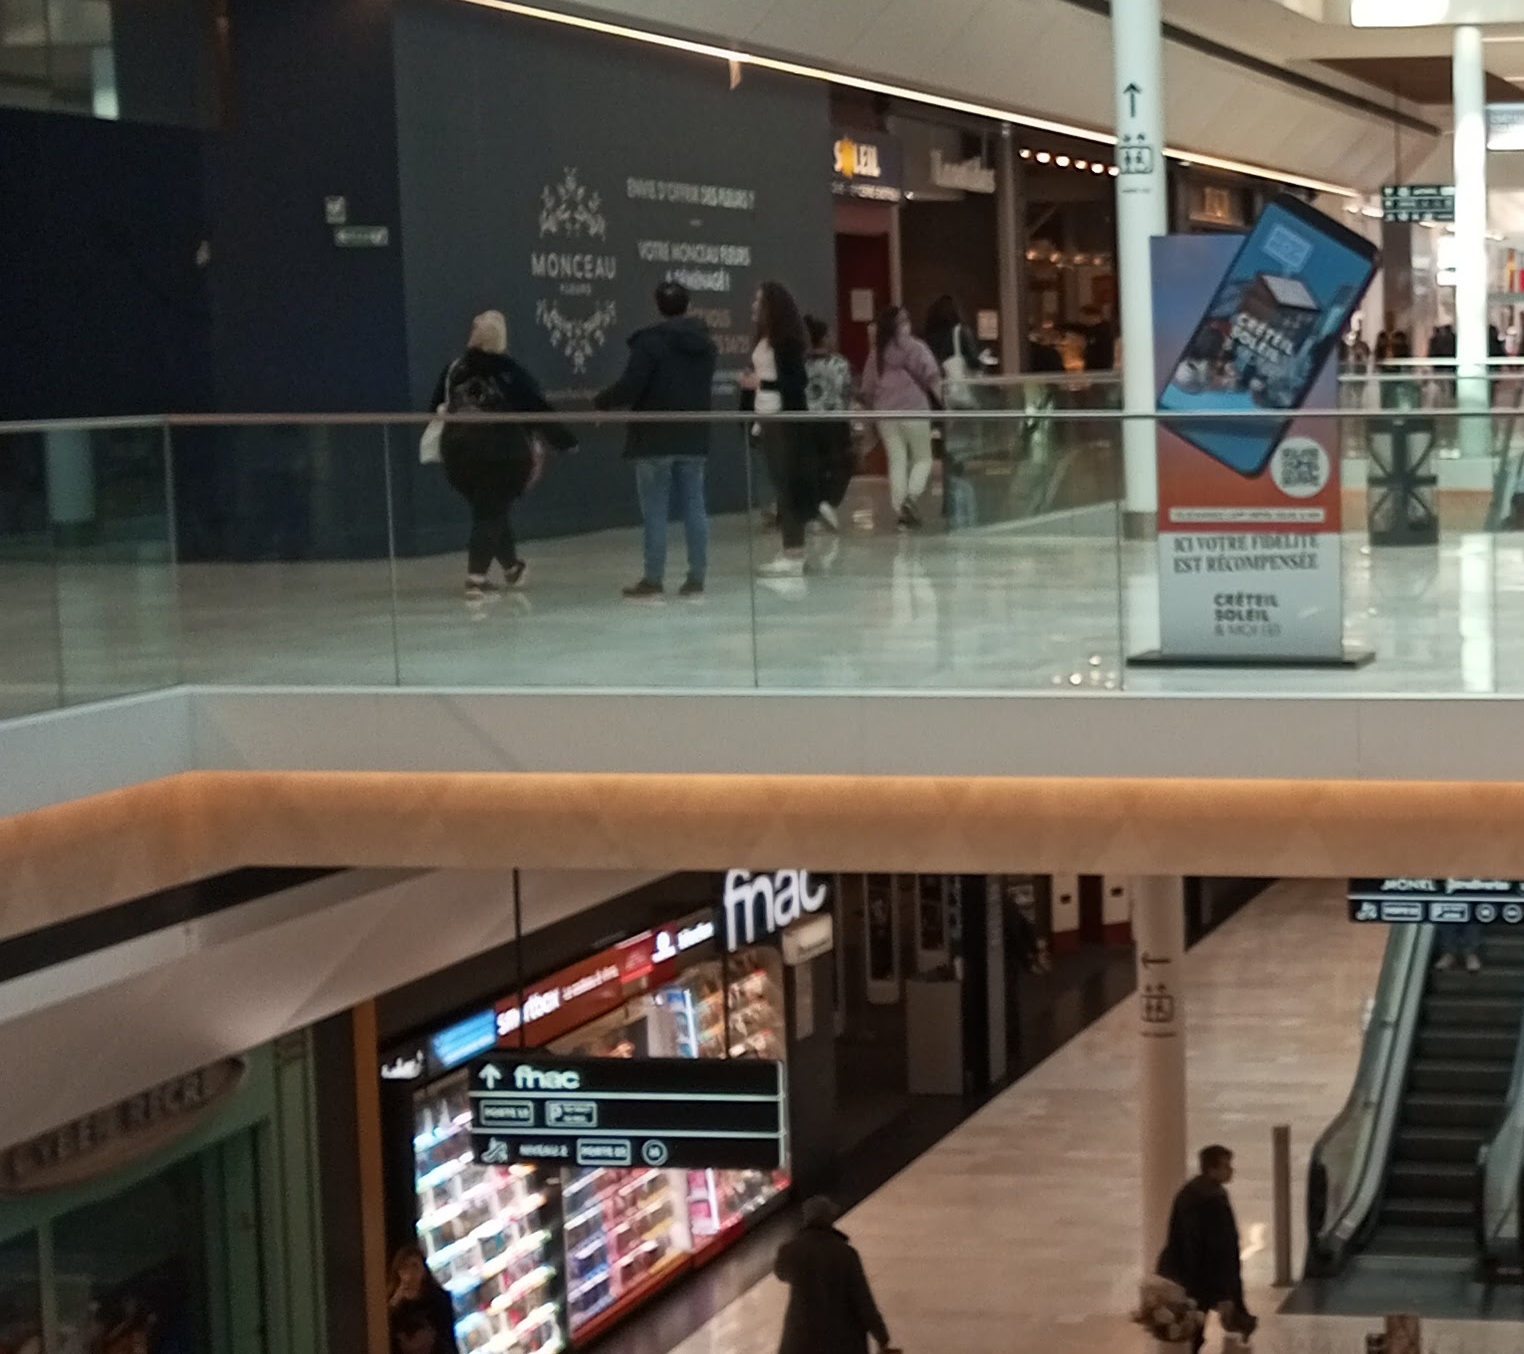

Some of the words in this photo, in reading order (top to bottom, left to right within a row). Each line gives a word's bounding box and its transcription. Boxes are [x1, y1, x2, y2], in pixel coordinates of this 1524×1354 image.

[531, 252, 617, 279] MONCEAU
[1231, 326, 1280, 364] SOLEIL
[1196, 536, 1248, 551] VOTRE
[1174, 556, 1201, 573] EST
[1213, 592, 1279, 607] CRÉTEIL
[1214, 608, 1269, 622] SOLEIL
[724, 868, 826, 951] fnac
[513, 1064, 581, 1089] fnac
